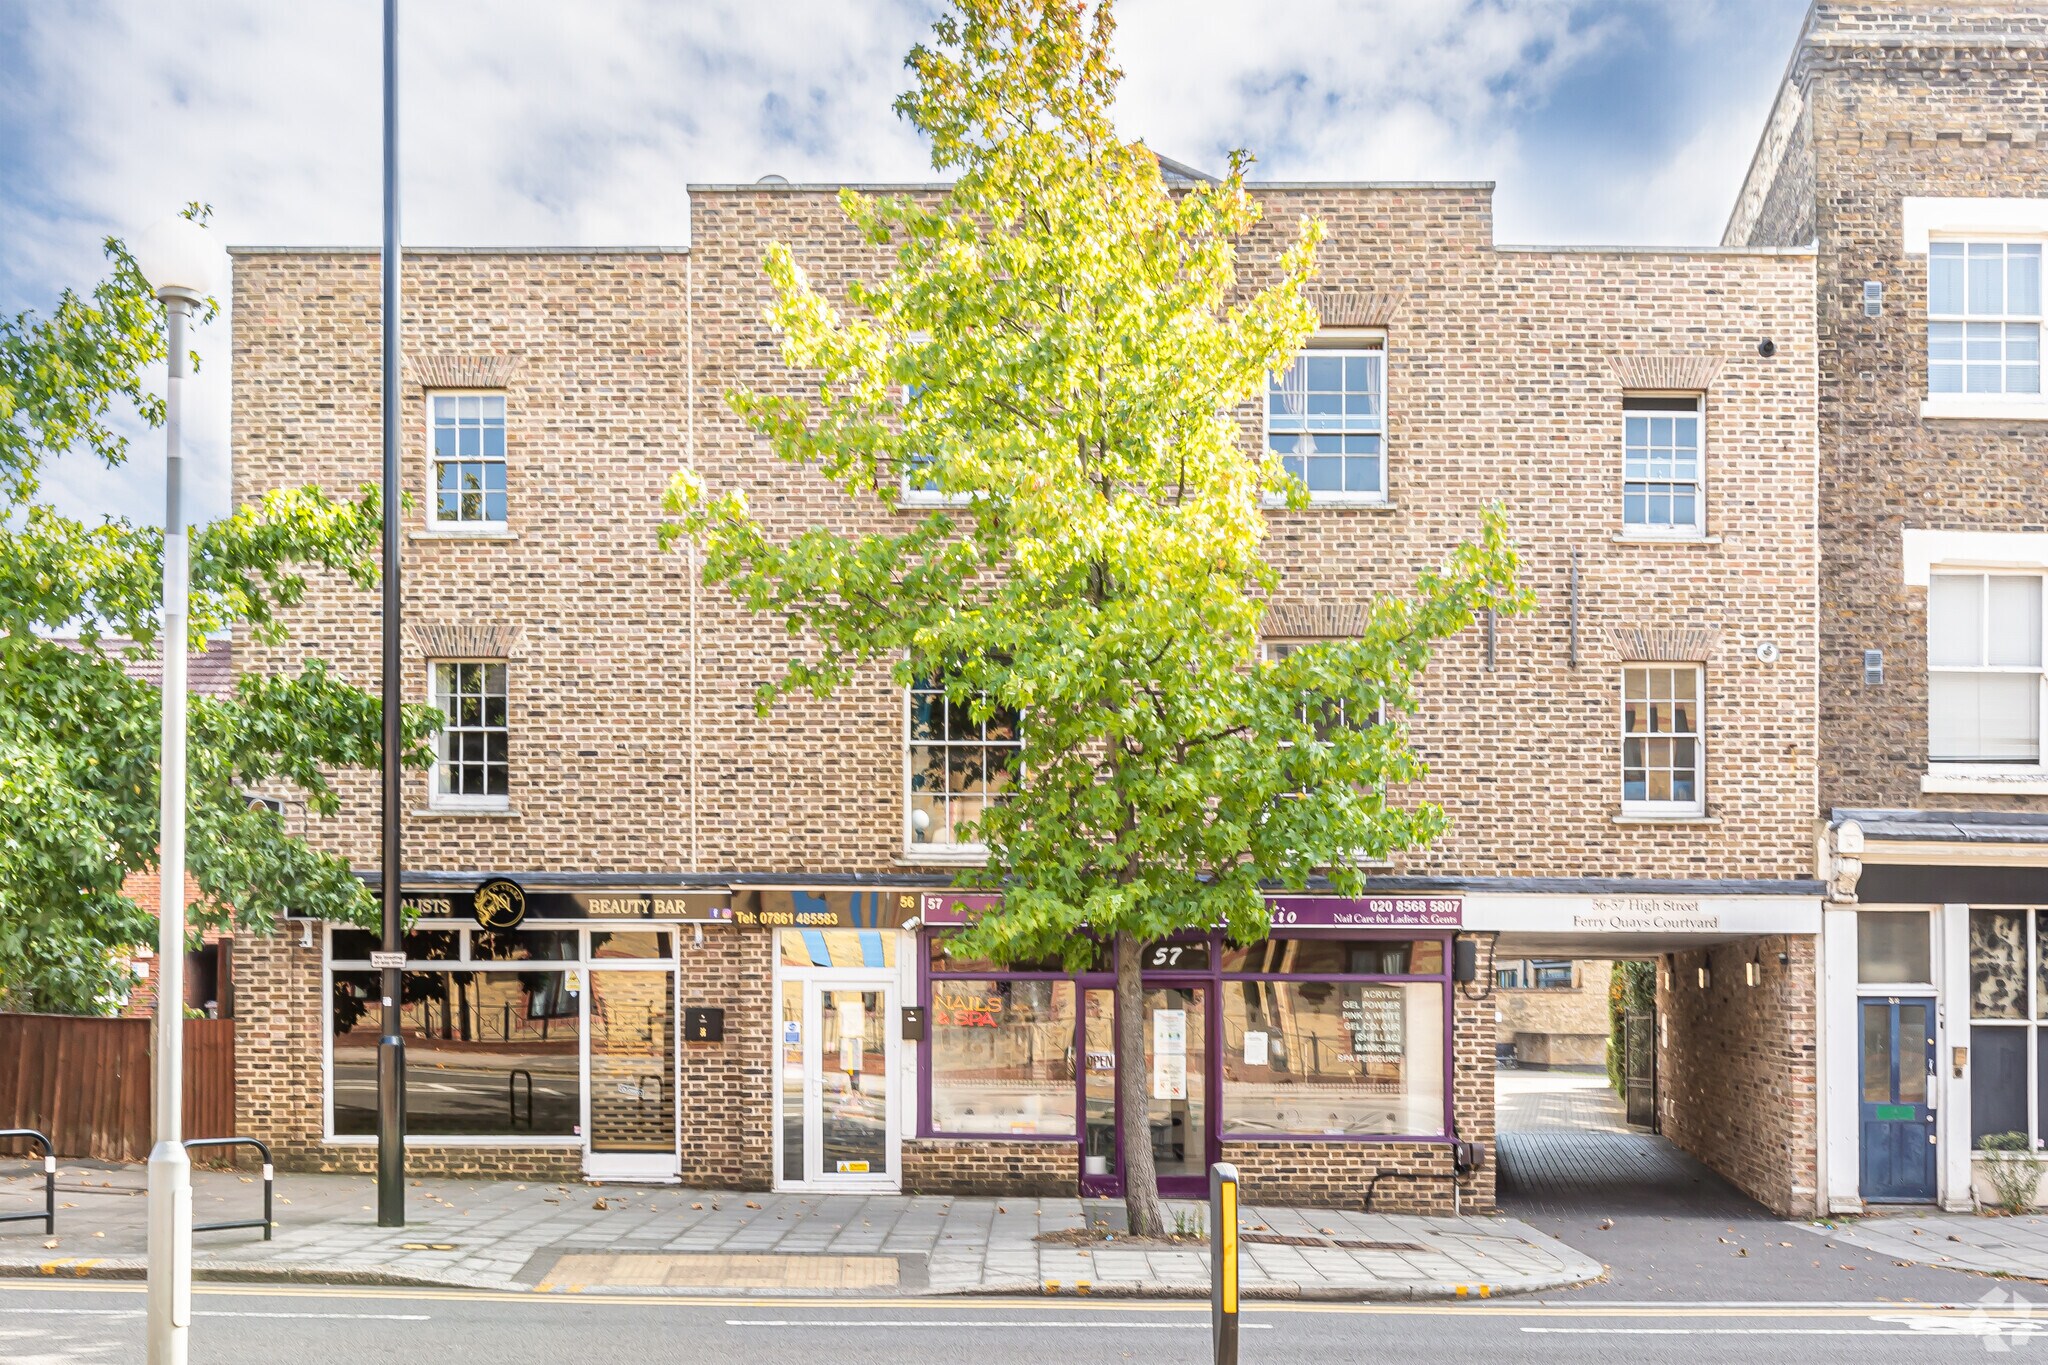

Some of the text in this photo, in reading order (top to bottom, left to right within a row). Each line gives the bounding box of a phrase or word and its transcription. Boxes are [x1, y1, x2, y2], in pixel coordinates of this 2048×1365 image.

[588, 898, 687, 914] BEAUTY BAR
[900, 895, 915, 908] 56
[927, 897, 943, 910] 57
[1369, 900, 1460, 913] 020 8568 5807
[1628, 899, 1660, 914] High
[1662, 899, 1699, 912] Street
[735, 911, 757, 924] Tel:
[760, 911, 794, 925] 07861
[1333, 913, 1458, 924] Nail Care for Ladies & Gents
[1573, 915, 1718, 931] Ferry Quays Courtyard
[1152, 946, 1183, 966] 57
[1362, 990, 1401, 999] ACRYLIC
[934, 995, 1003, 1012] NAILS
[1342, 1000, 1401, 1010] GEL POWDER
[954, 1010, 998, 1028] SPA
[1342, 1011, 1362, 1020] PINK
[1343, 1021, 1361, 1031] GEL
[1354, 1043, 1401, 1052] MANICURE
[1086, 1055, 1114, 1069] OPEN
[1337, 1054, 1401, 1063] SPA PEDICURE
